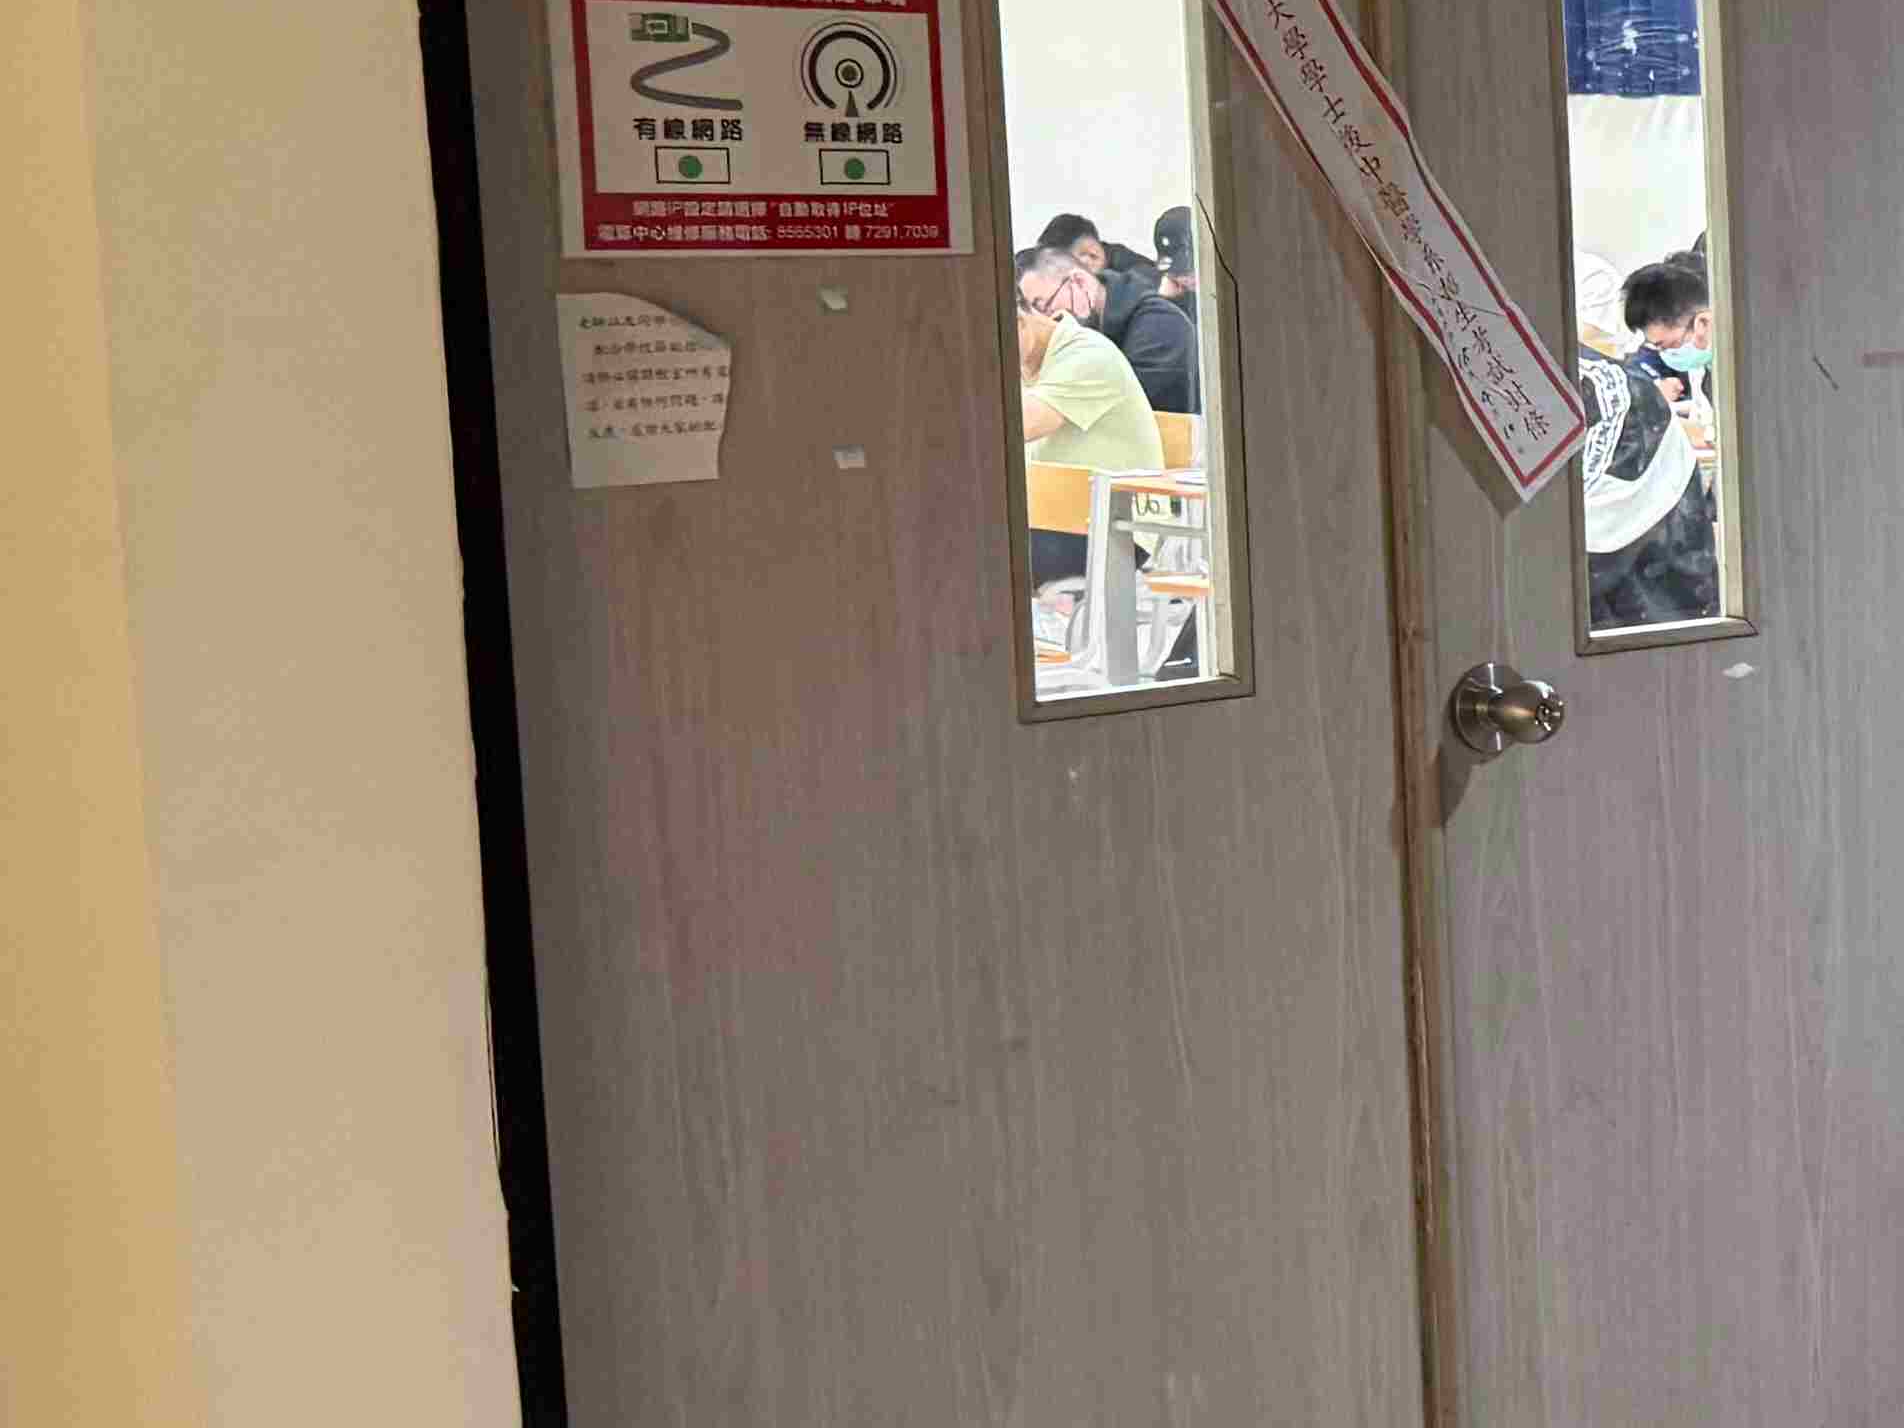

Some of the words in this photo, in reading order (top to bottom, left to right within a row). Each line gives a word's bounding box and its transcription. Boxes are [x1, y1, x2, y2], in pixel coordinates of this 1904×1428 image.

[632, 117, 744, 143] 有線網路
[803, 121, 905, 145] 無線網路
